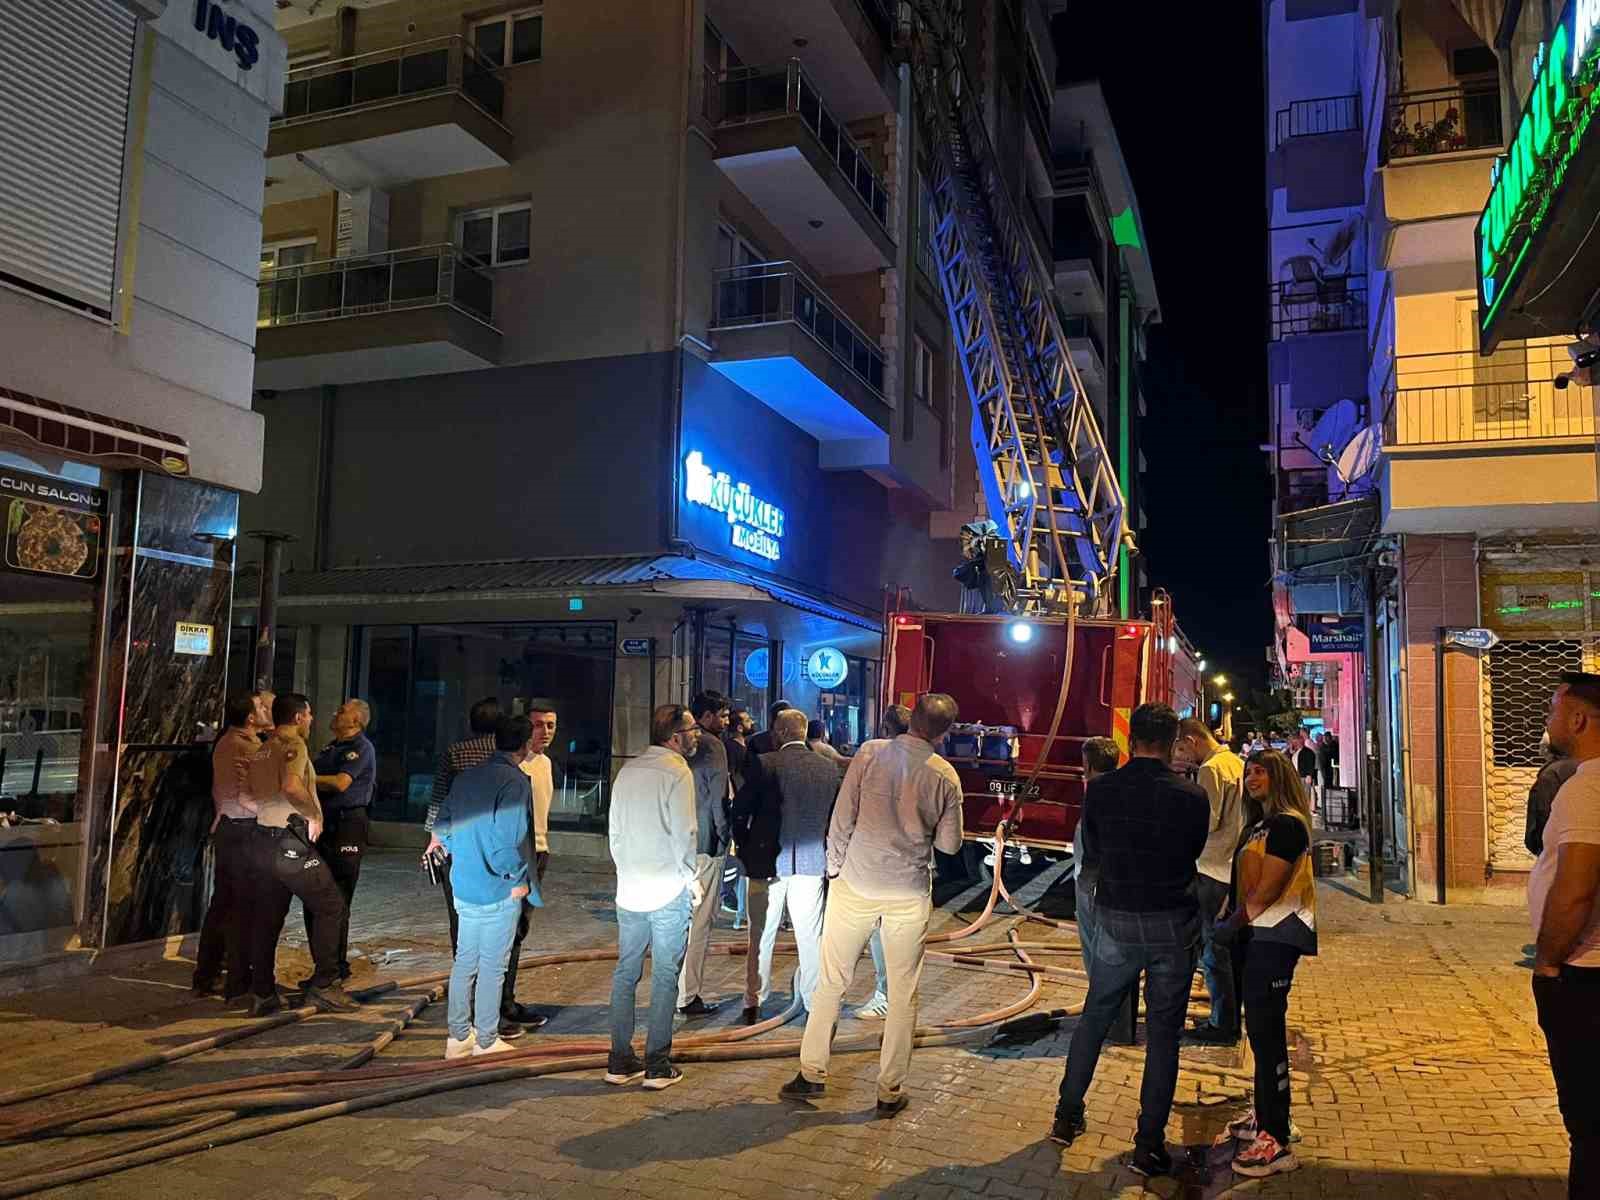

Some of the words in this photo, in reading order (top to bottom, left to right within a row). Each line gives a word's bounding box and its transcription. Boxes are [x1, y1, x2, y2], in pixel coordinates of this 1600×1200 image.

[37, 485, 101, 507] SALONU
[710, 472, 784, 537] KÜÇÜKLER
[990, 782, 1001, 792] 09
